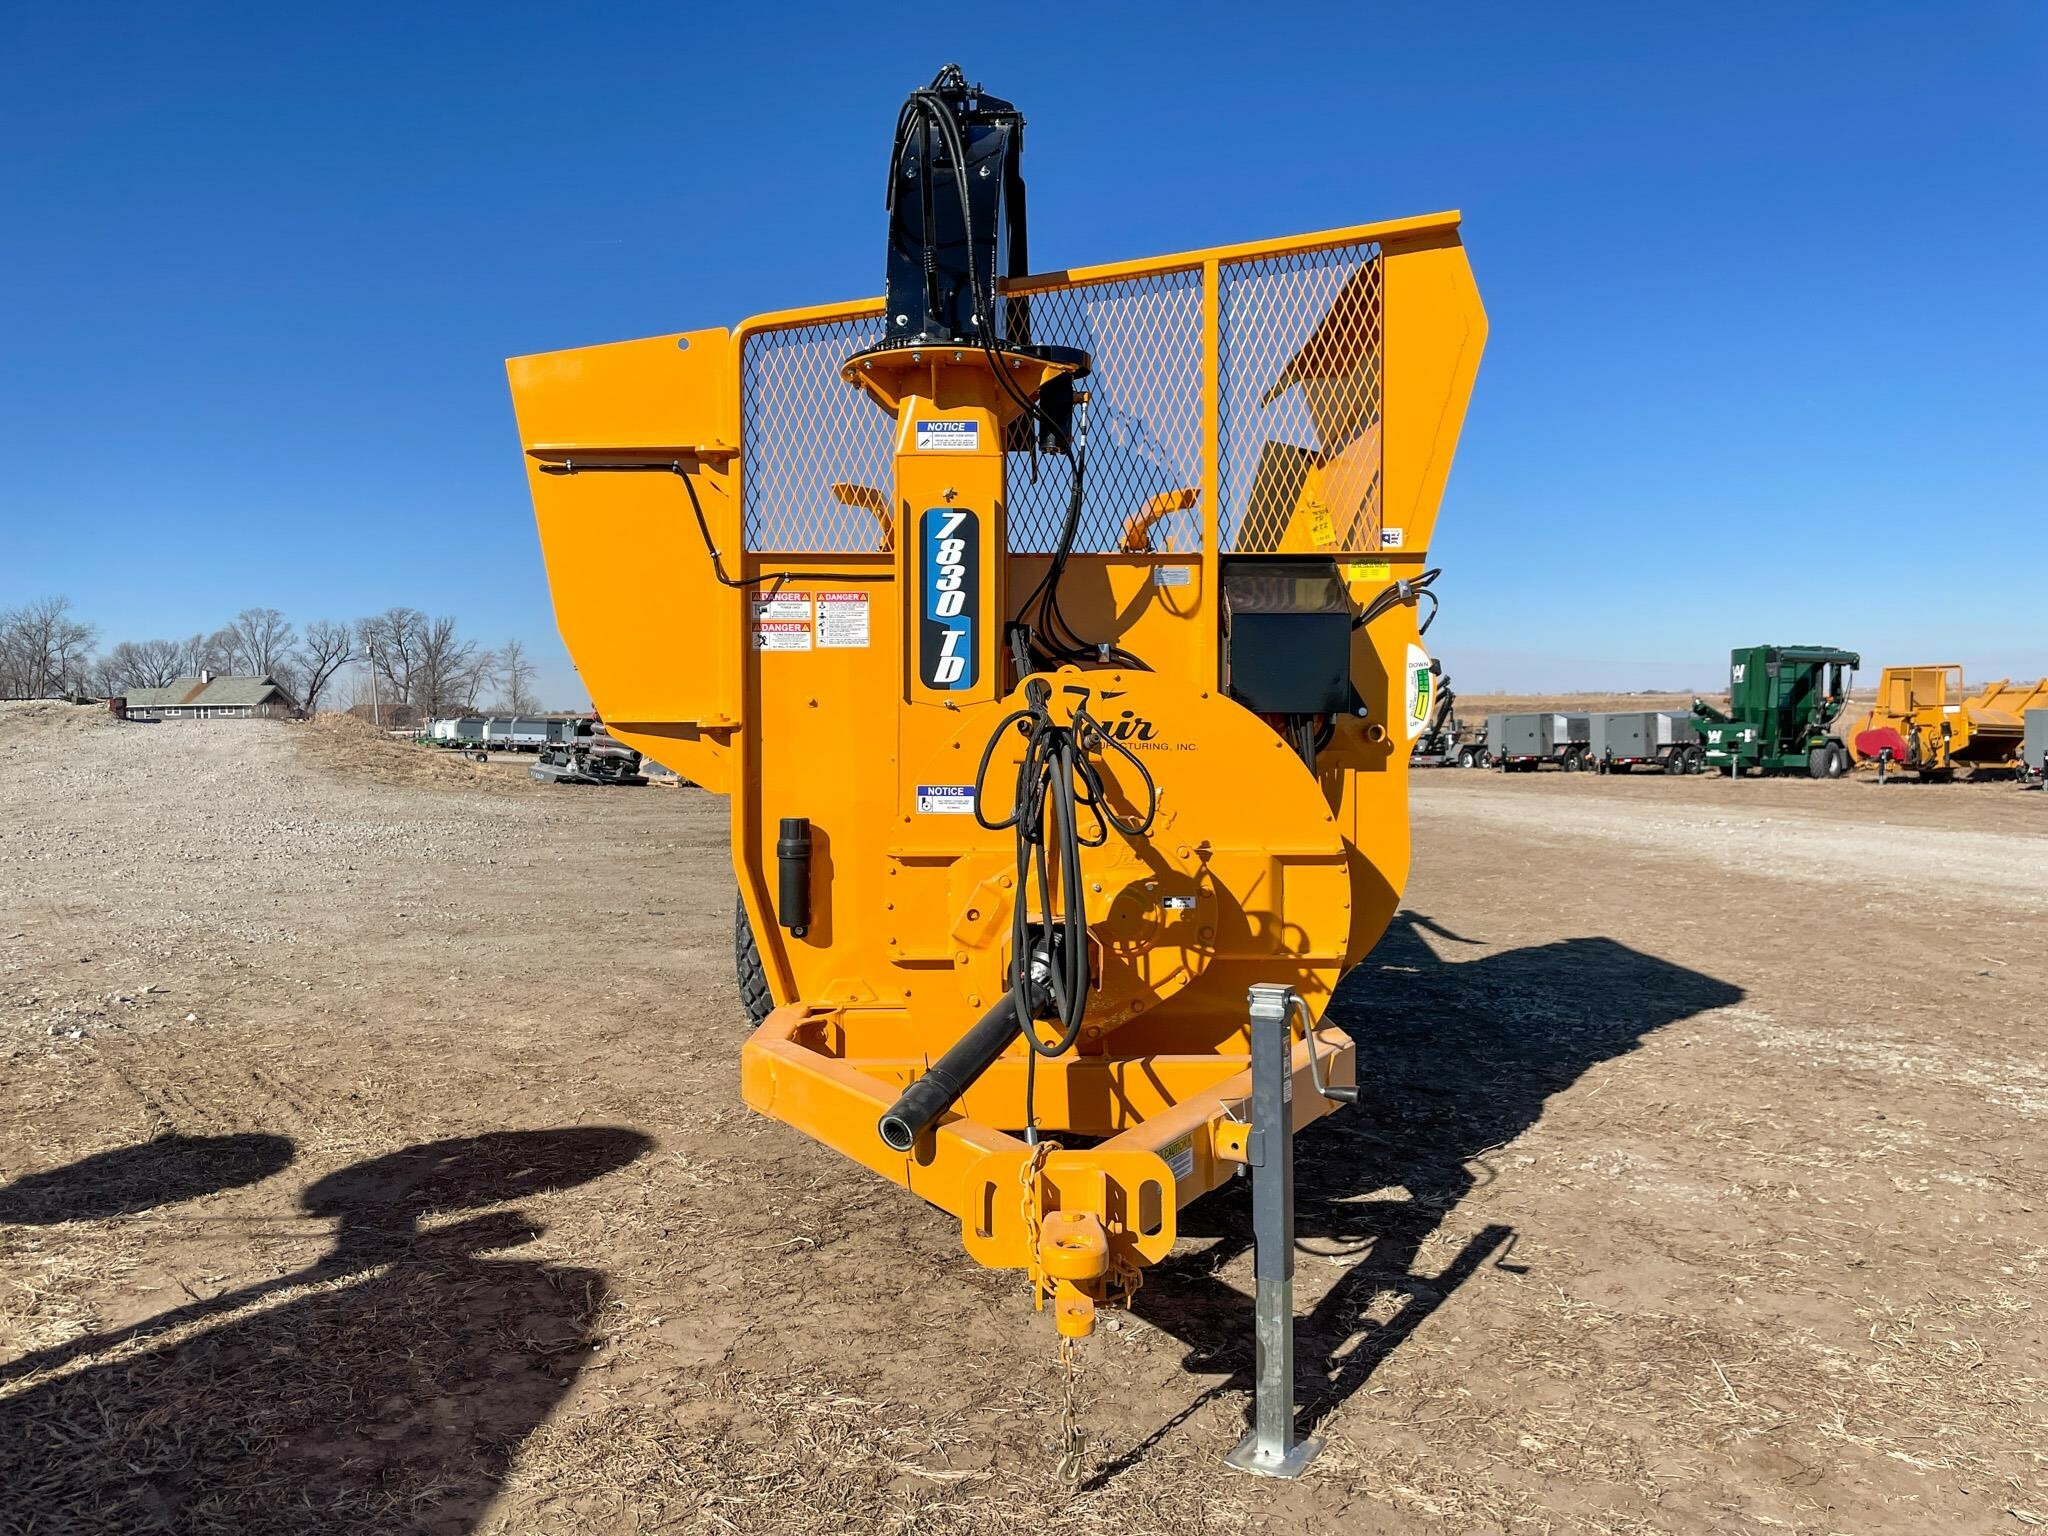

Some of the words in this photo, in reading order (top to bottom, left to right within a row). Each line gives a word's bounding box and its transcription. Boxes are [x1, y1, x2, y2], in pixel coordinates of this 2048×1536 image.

[927, 422, 966, 431] NOTICE
[934, 512, 967, 617] 7830
[762, 593, 801, 601] DANGER
[826, 593, 860, 601] DANGER
[761, 623, 802, 632] DANGER
[933, 630, 966, 683] TD
[1176, 743, 1199, 751] INC.
[927, 786, 964, 796] NOTICE
